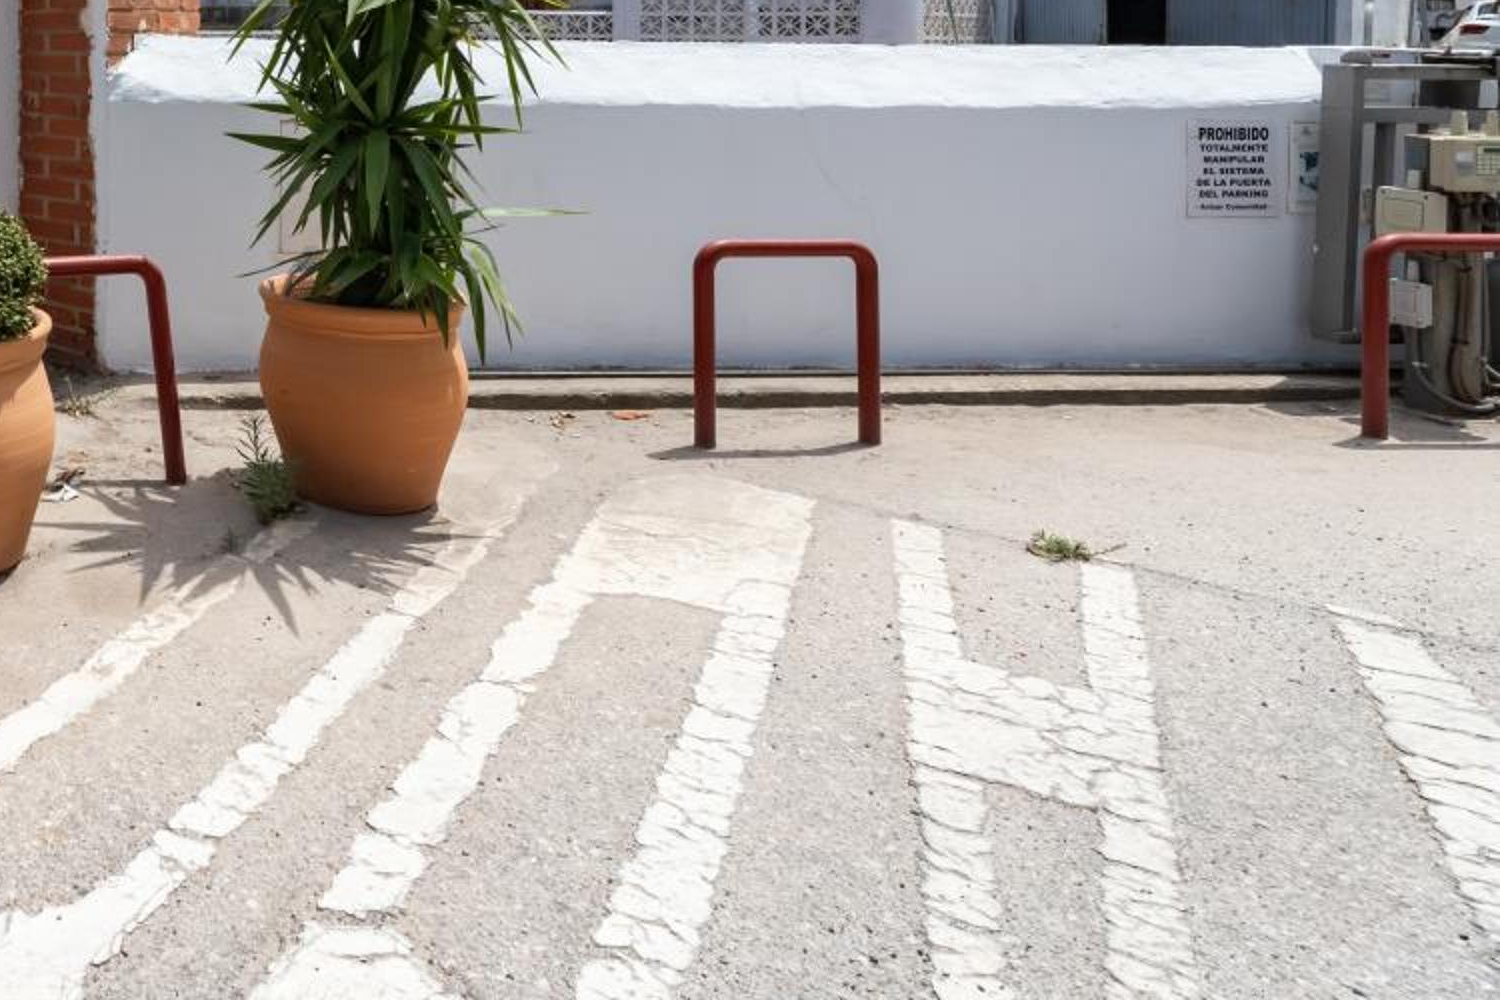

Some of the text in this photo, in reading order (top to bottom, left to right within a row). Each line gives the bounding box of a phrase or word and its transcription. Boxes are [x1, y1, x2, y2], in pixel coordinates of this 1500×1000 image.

[1198, 127, 1269, 141] PROHIBIDO
[1200, 144, 1269, 153] TOTALMENTE
[1203, 167, 1265, 175] EL SISTEMA
[1197, 179, 1271, 187] DE LA PUERTA
[1199, 190, 1269, 198] DEL PARKING
